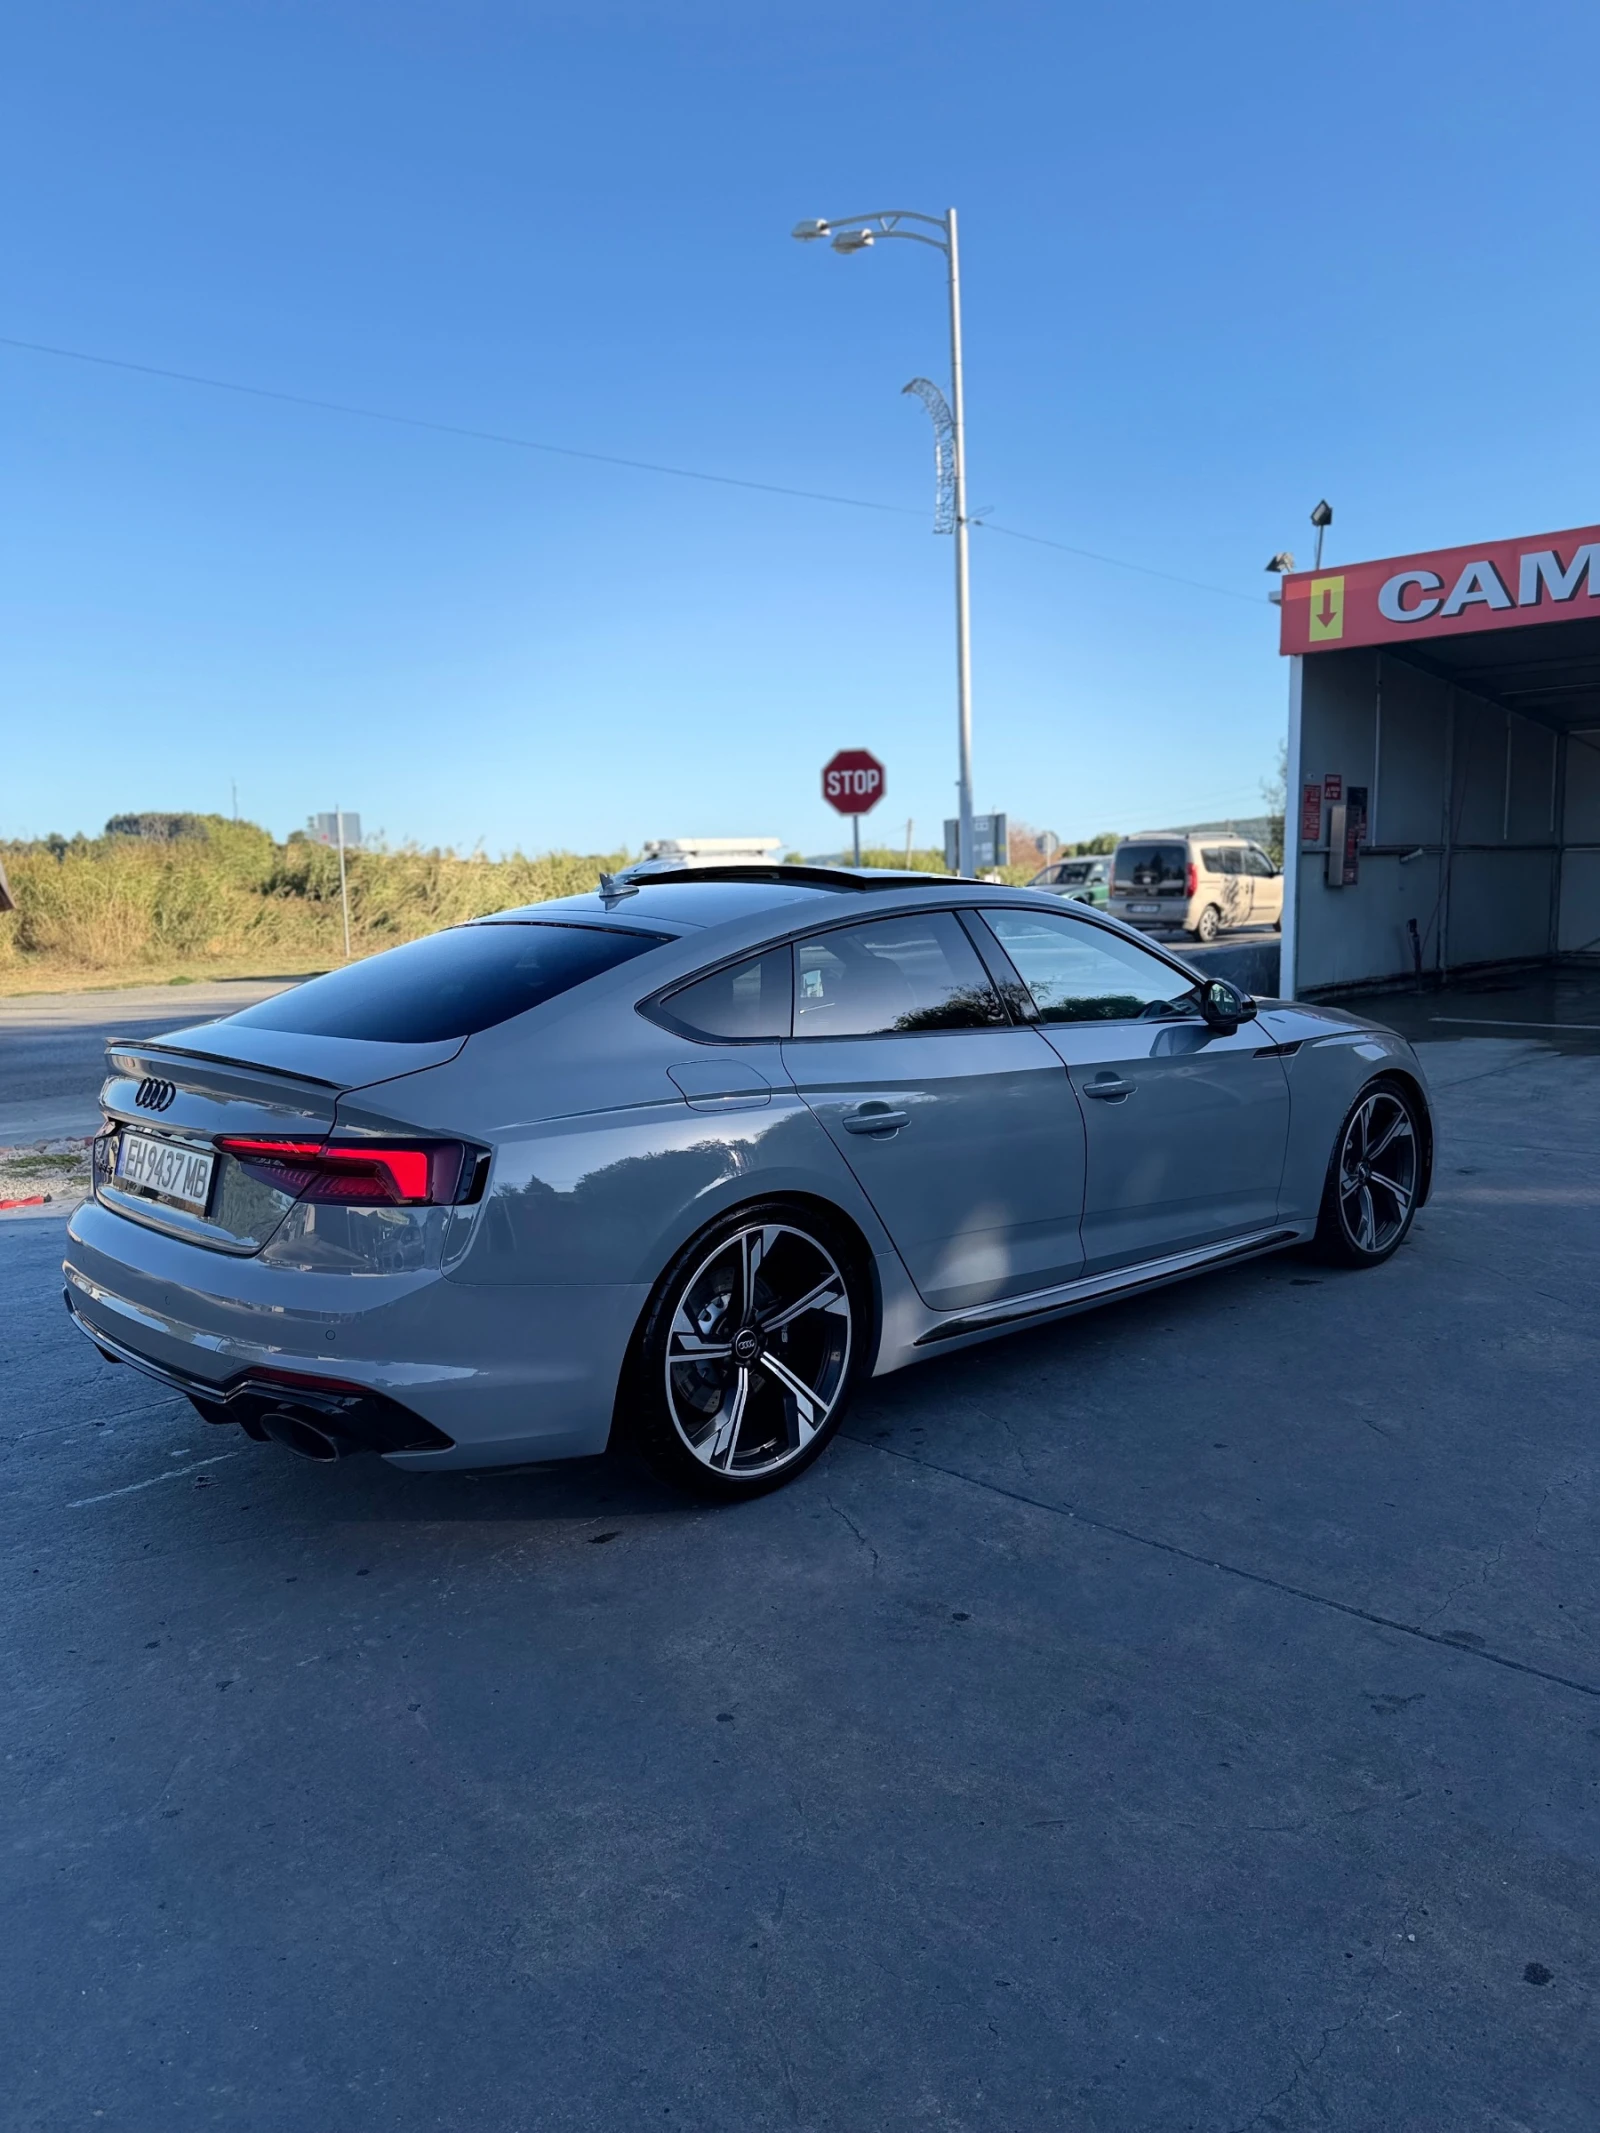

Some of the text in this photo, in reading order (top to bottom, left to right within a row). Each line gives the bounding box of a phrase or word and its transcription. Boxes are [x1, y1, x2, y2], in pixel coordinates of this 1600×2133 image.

[827, 769, 880, 796] STOP
[147, 1145, 186, 1190] 9437
[183, 1156, 210, 1199] MB
